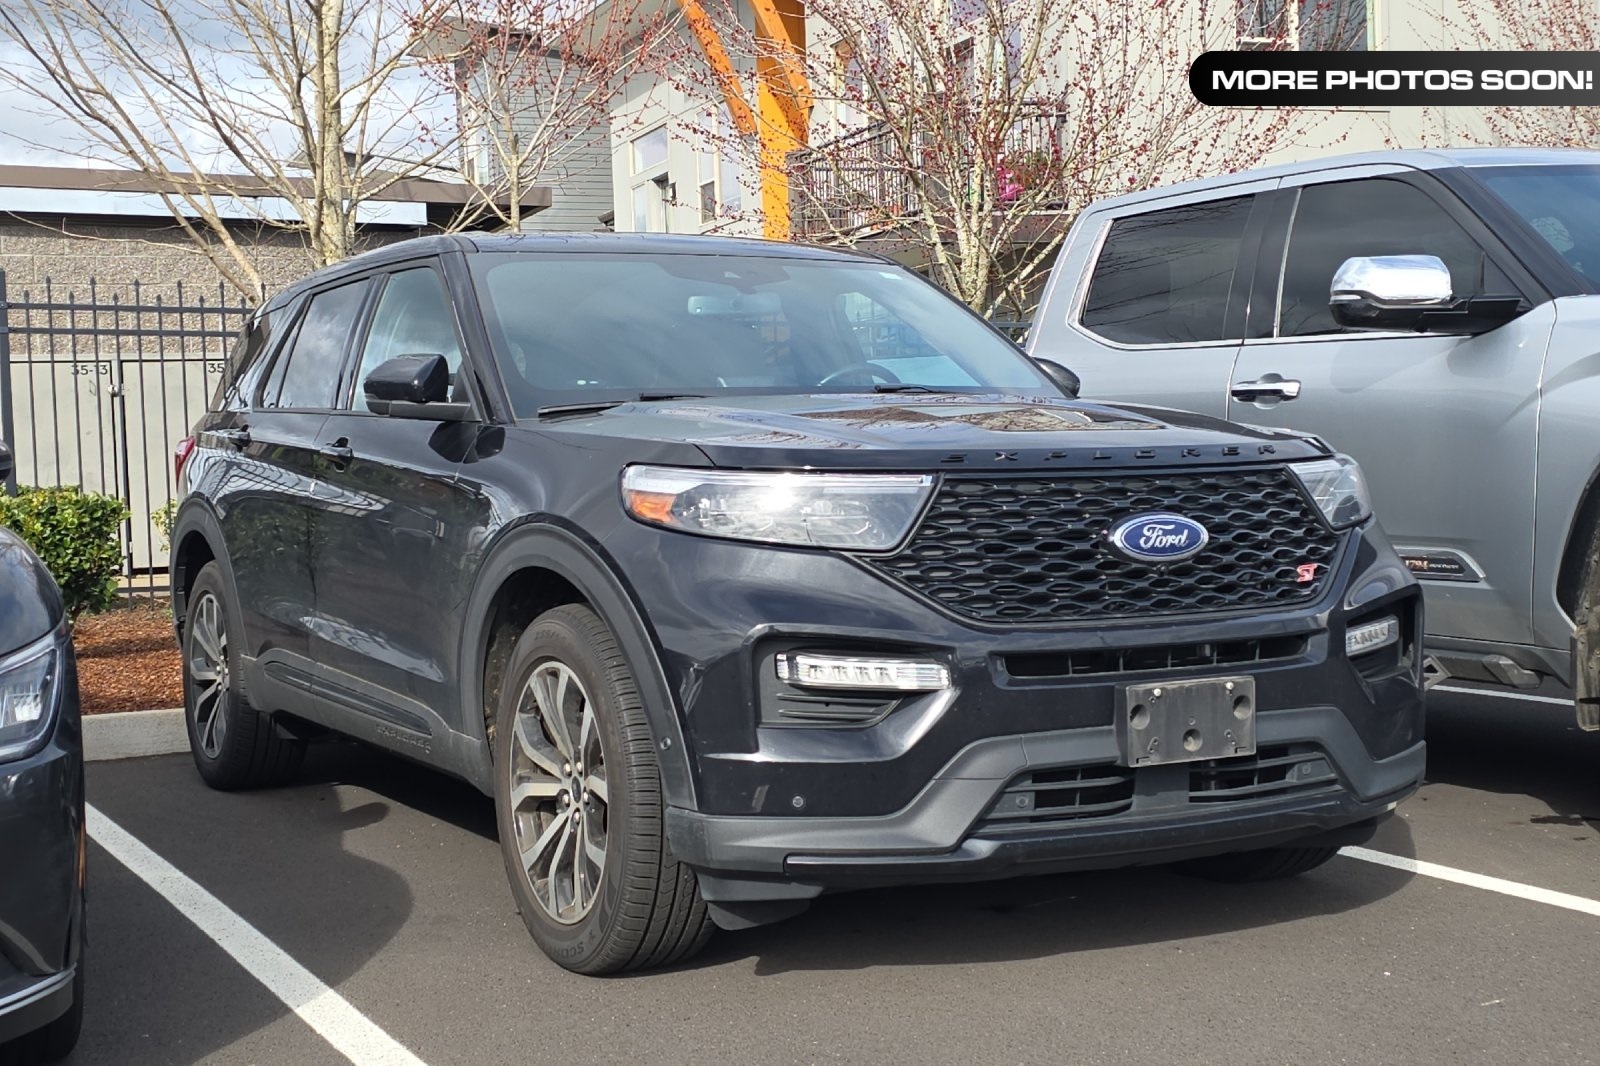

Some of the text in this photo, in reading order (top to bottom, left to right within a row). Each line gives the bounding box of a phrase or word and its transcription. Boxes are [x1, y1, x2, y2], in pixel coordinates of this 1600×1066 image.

[940, 445, 1277, 463] EXPLORER
[1139, 523, 1189, 549] Ford
[1296, 563, 1318, 582] ST
